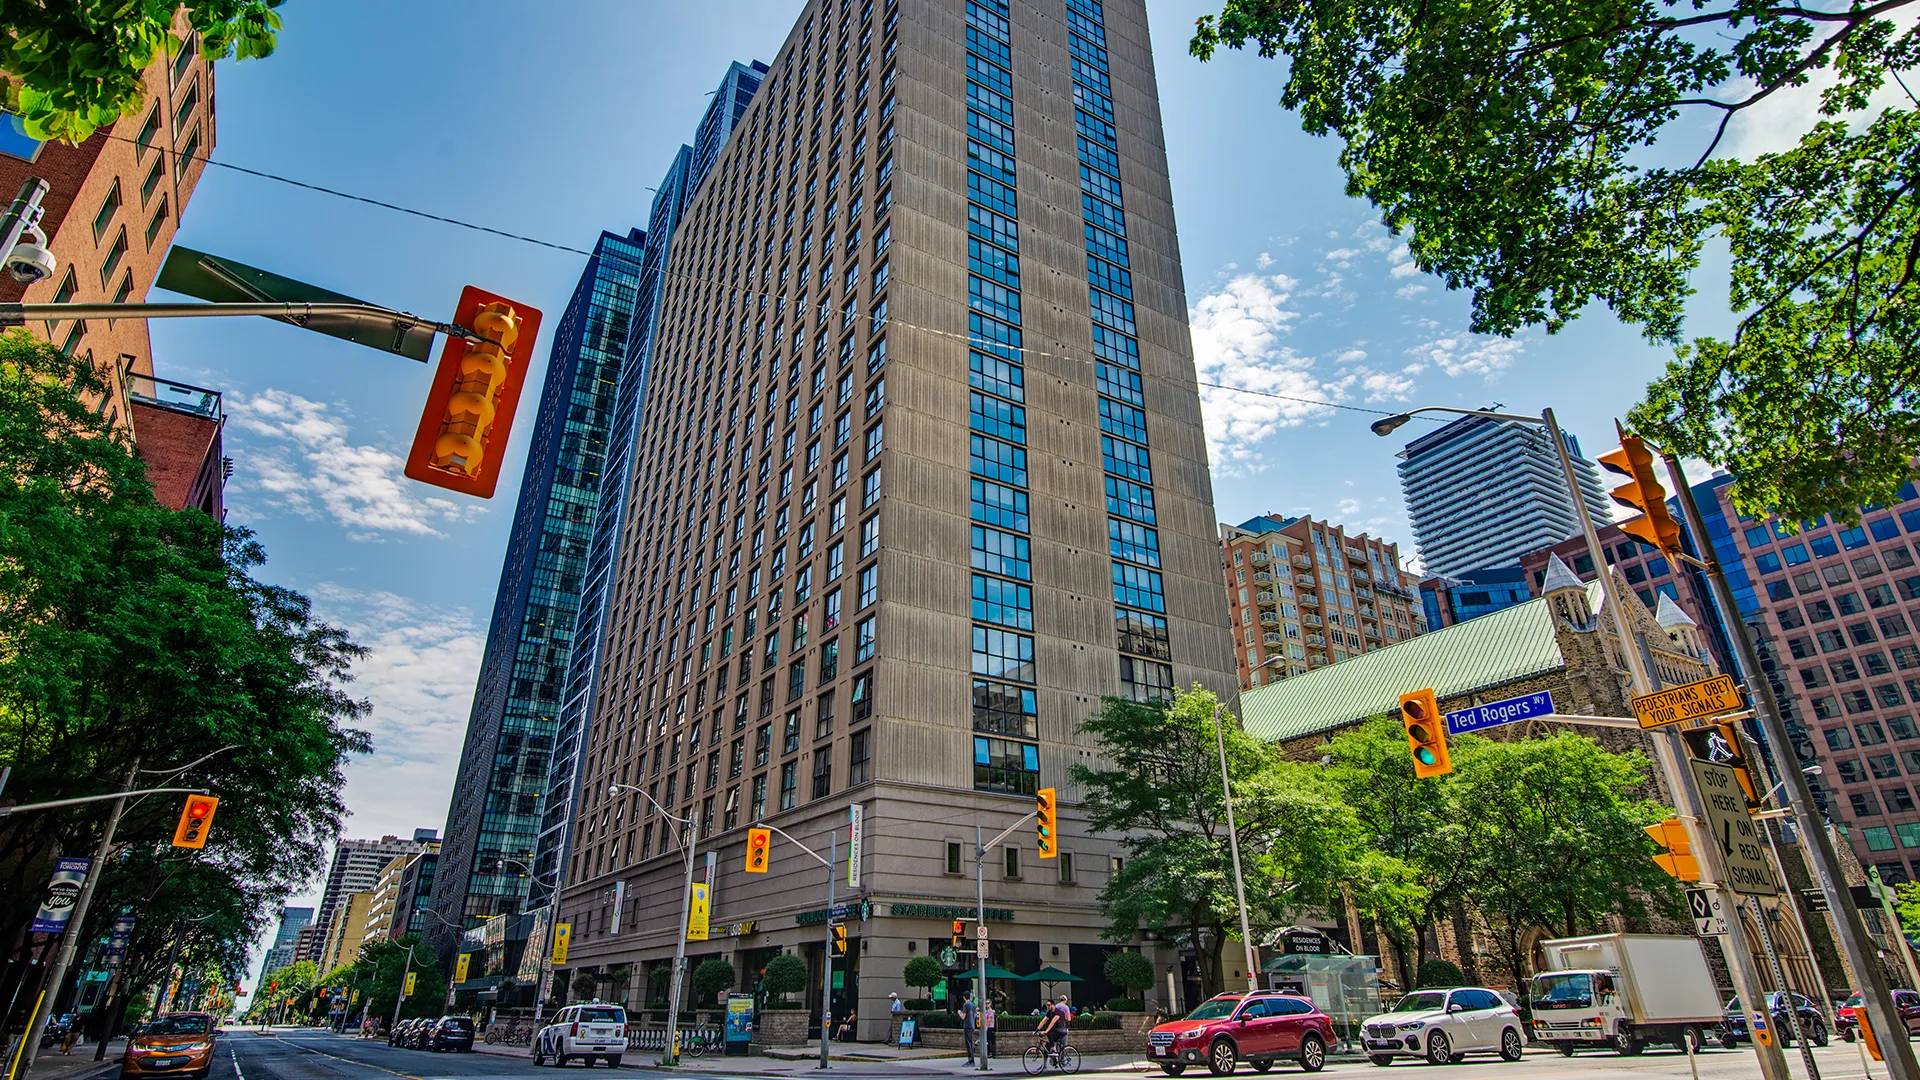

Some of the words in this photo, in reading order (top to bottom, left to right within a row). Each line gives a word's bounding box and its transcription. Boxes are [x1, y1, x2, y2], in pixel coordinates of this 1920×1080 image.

[1636, 687, 1699, 714] PEDESTRIANS
[1703, 678, 1730, 697] OBEY
[1451, 710, 1476, 729] Ted
[1480, 701, 1531, 723] Rogers
[1532, 695, 1545, 705] Wy
[1649, 707, 1678, 723] YOUR
[1681, 695, 1726, 717] SIGNALS
[1703, 769, 1728, 789] STOP
[1710, 793, 1740, 813] HERE
[854, 832, 859, 841] ON
[1736, 819, 1753, 837] ON
[1738, 842, 1760, 861] RED
[1732, 865, 1770, 886] SIGNAL
[48, 895, 71, 910] you
[891, 903, 968, 918] STARBUCKS
[1292, 936, 1321, 945] RESIDENCES
